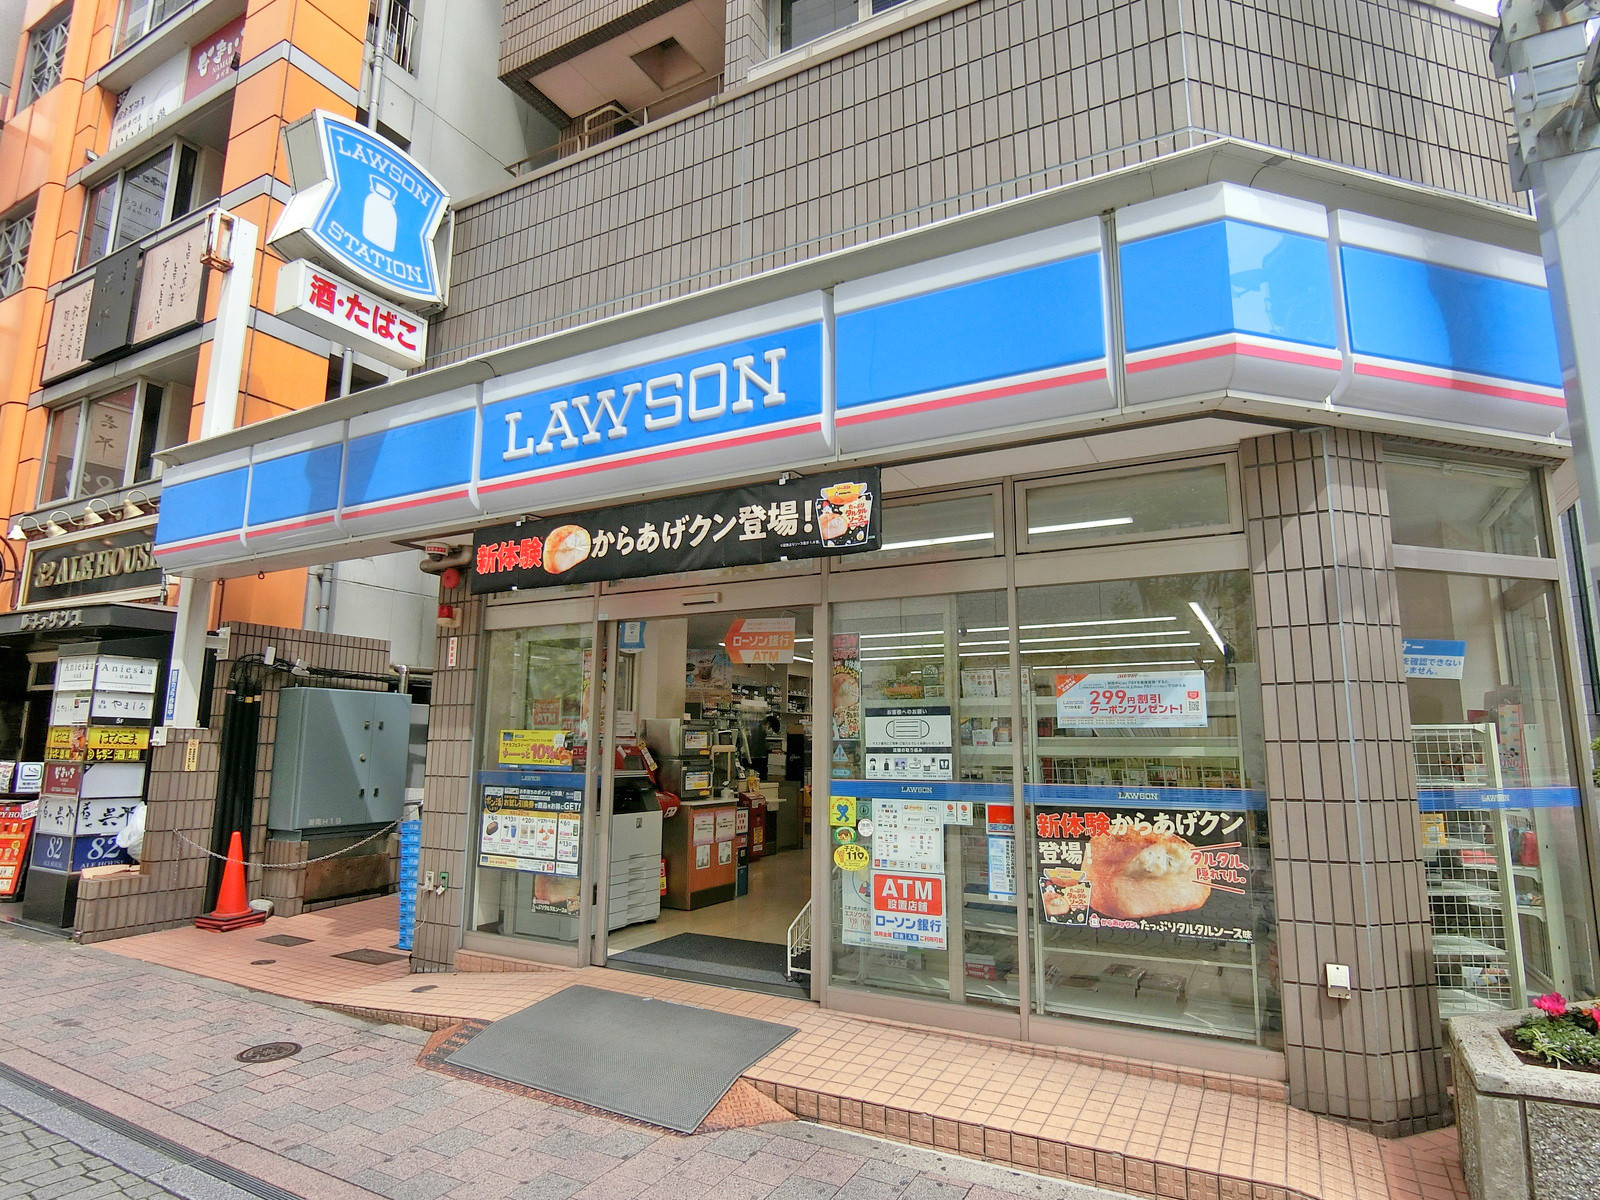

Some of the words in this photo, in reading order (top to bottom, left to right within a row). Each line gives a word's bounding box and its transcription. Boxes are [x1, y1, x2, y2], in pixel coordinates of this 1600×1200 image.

[336, 136, 432, 208] LAWSON
[327, 220, 424, 284] STATION
[308, 274, 417, 352] 酒・たばこ
[503, 347, 786, 462] LAWSON
[476, 536, 543, 576] 新体験
[54, 552, 95, 585] ALE
[733, 634, 790, 647] ローソン銀行
[752, 651, 779, 662] ATM
[1089, 689, 1161, 705] 299円割引
[1089, 704, 1183, 715] クーポンプレゼント!
[531, 743, 555, 759] 10%
[1118, 792, 1158, 800] LAWSON
[989, 823, 1014, 831] SECOM
[1036, 810, 1244, 838] 新体験からあげクン
[47, 837, 63, 859] 82
[87, 837, 120, 860] 82
[1038, 840, 1093, 866] 登場!
[1195, 867, 1247, 884] 隠れてル。
[881, 878, 933, 900] ATM
[887, 898, 928, 913] 設置店舗
[875, 915, 942, 933] ローソン銀行
